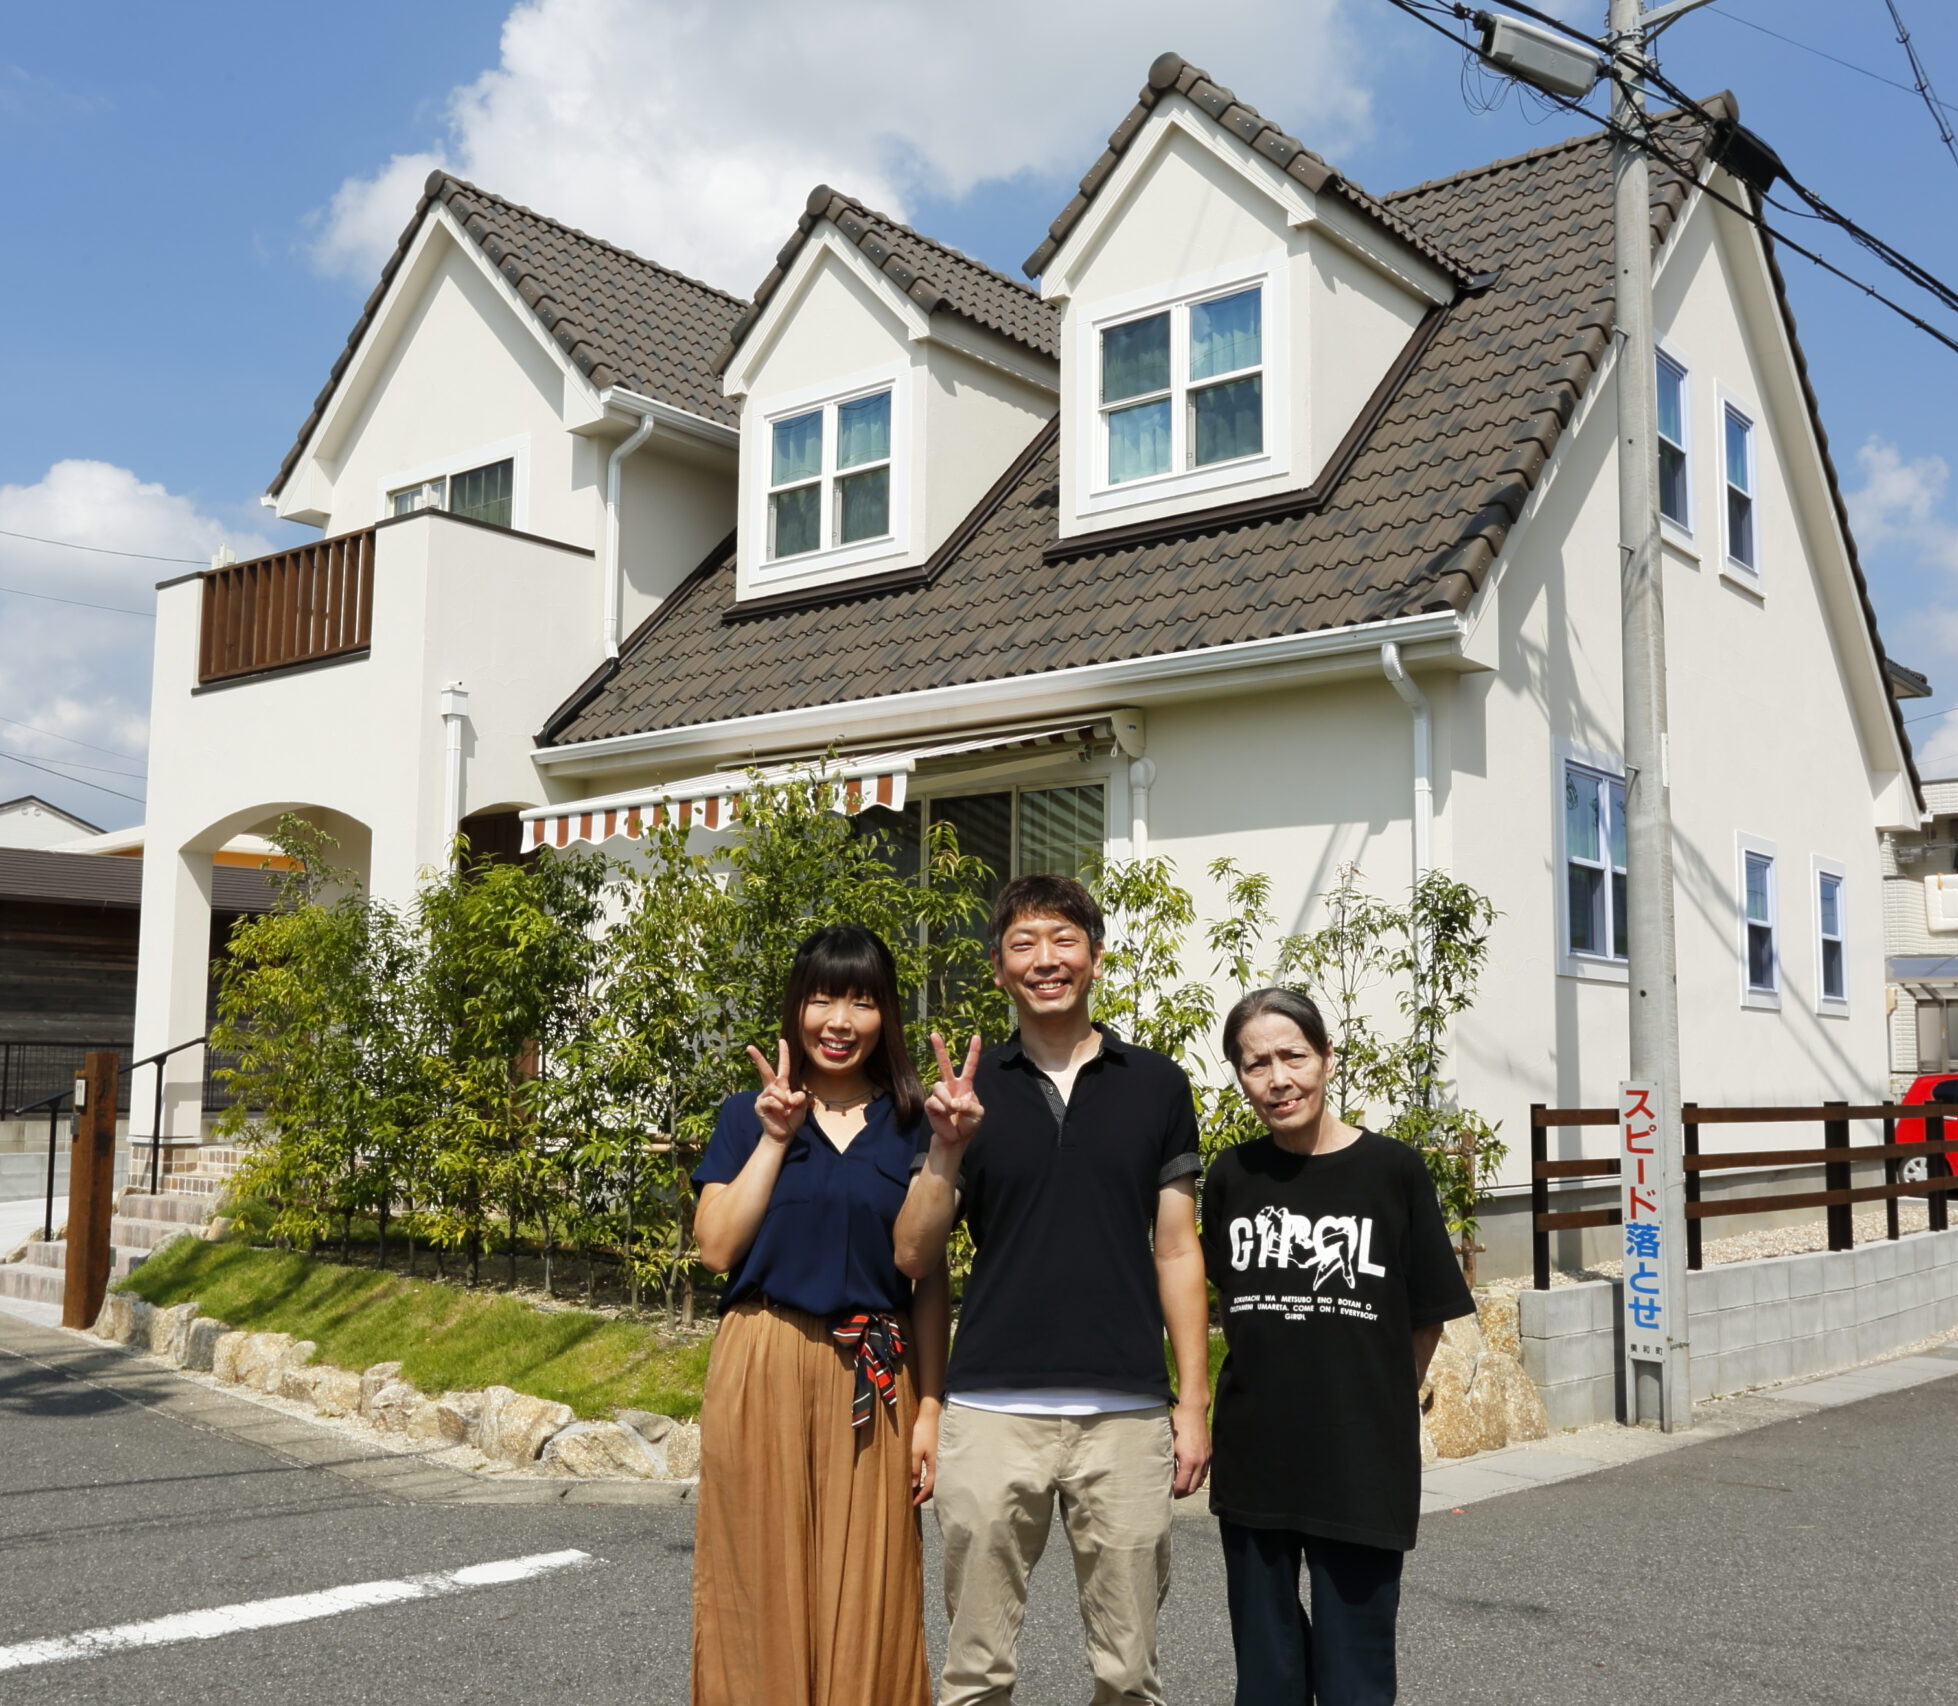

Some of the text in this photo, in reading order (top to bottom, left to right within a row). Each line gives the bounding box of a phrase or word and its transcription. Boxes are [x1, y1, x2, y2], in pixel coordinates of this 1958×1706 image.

[1624, 1089, 1662, 1330] スピード落とせ
[1281, 1296, 1312, 1304] METSUBO
[1317, 1296, 1333, 1304] ENO
[1338, 1298, 1361, 1309] BOTAN
[1366, 1303, 1372, 1311] O
[1293, 1304, 1315, 1312] COME
[1340, 1308, 1378, 1321] EVERYBODY
